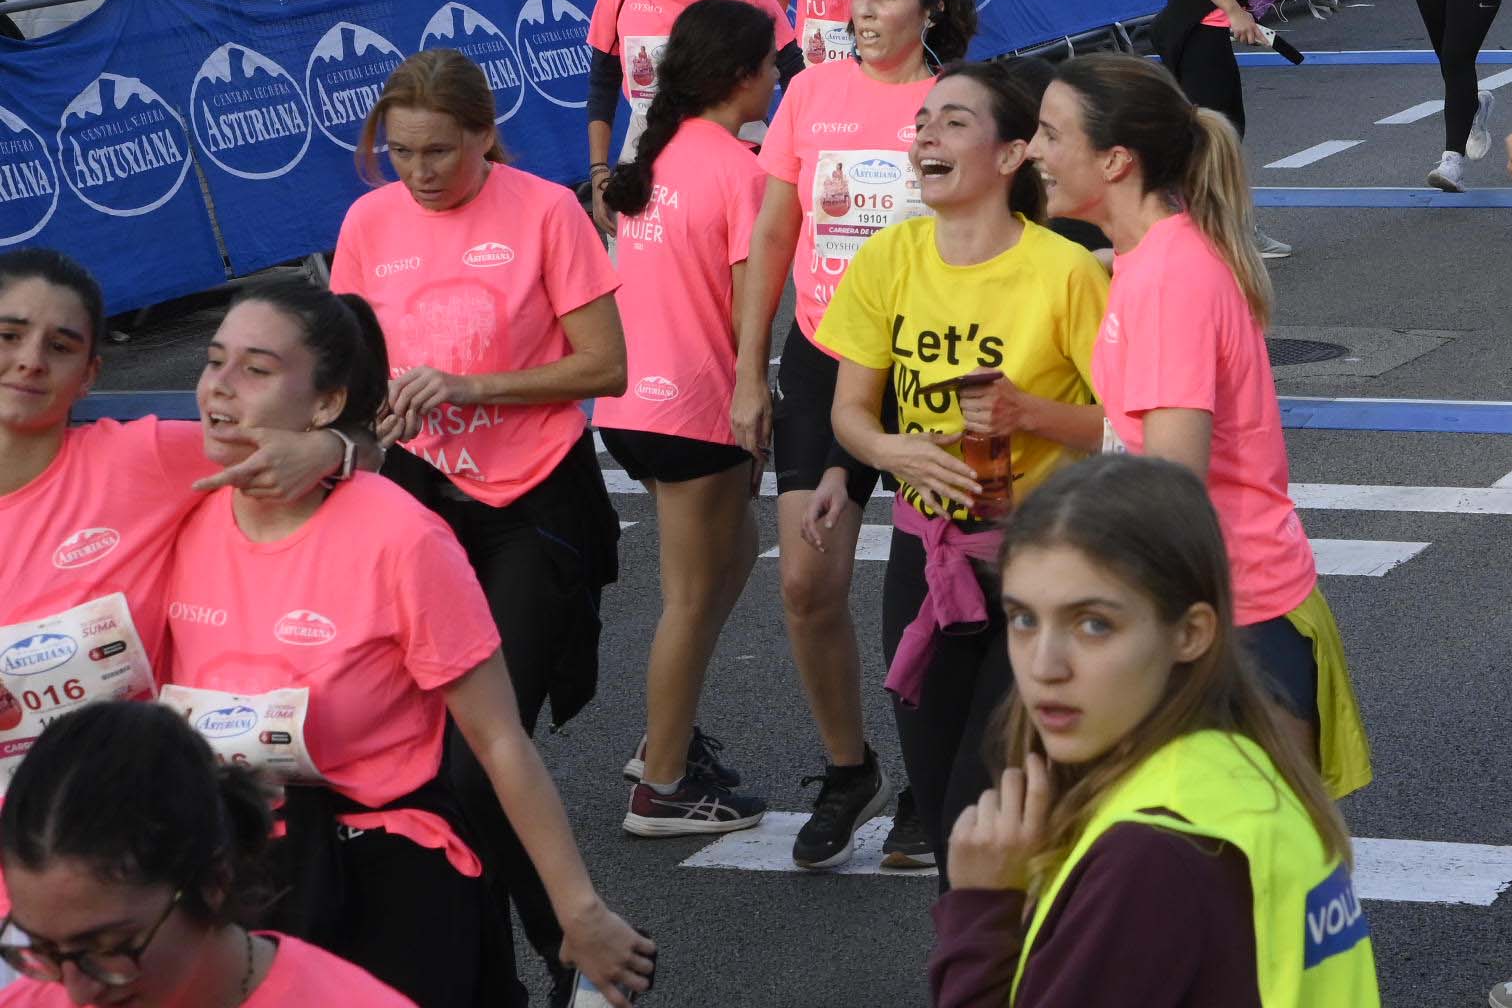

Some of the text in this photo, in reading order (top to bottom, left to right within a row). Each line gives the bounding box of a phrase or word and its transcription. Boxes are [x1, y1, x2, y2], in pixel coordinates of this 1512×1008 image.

[533, 31, 562, 45] CENTRAL
[326, 68, 362, 84] CENTRAL
[213, 82, 290, 107] CENTRAL LECHERA
[316, 78, 385, 127] ASTURI
[203, 100, 306, 153] ASTURIANA
[811, 122, 859, 134] OYSHO
[854, 168, 898, 179] ASTURIANA
[854, 193, 894, 209] 016
[858, 213, 888, 224] 19101
[466, 250, 511, 264] ASTURIANA
[375, 256, 421, 278] OYSHO
[59, 535, 115, 565] ASTURIANA
[168, 601, 228, 626] OYSHO
[82, 620, 118, 638] SUMA
[279, 622, 332, 640] ASTURIANA
[4, 644, 73, 671] ASTURIANA
[23, 678, 86, 712] 016
[200, 714, 253, 730] ASTURIANA
[264, 709, 295, 720] SUMA
